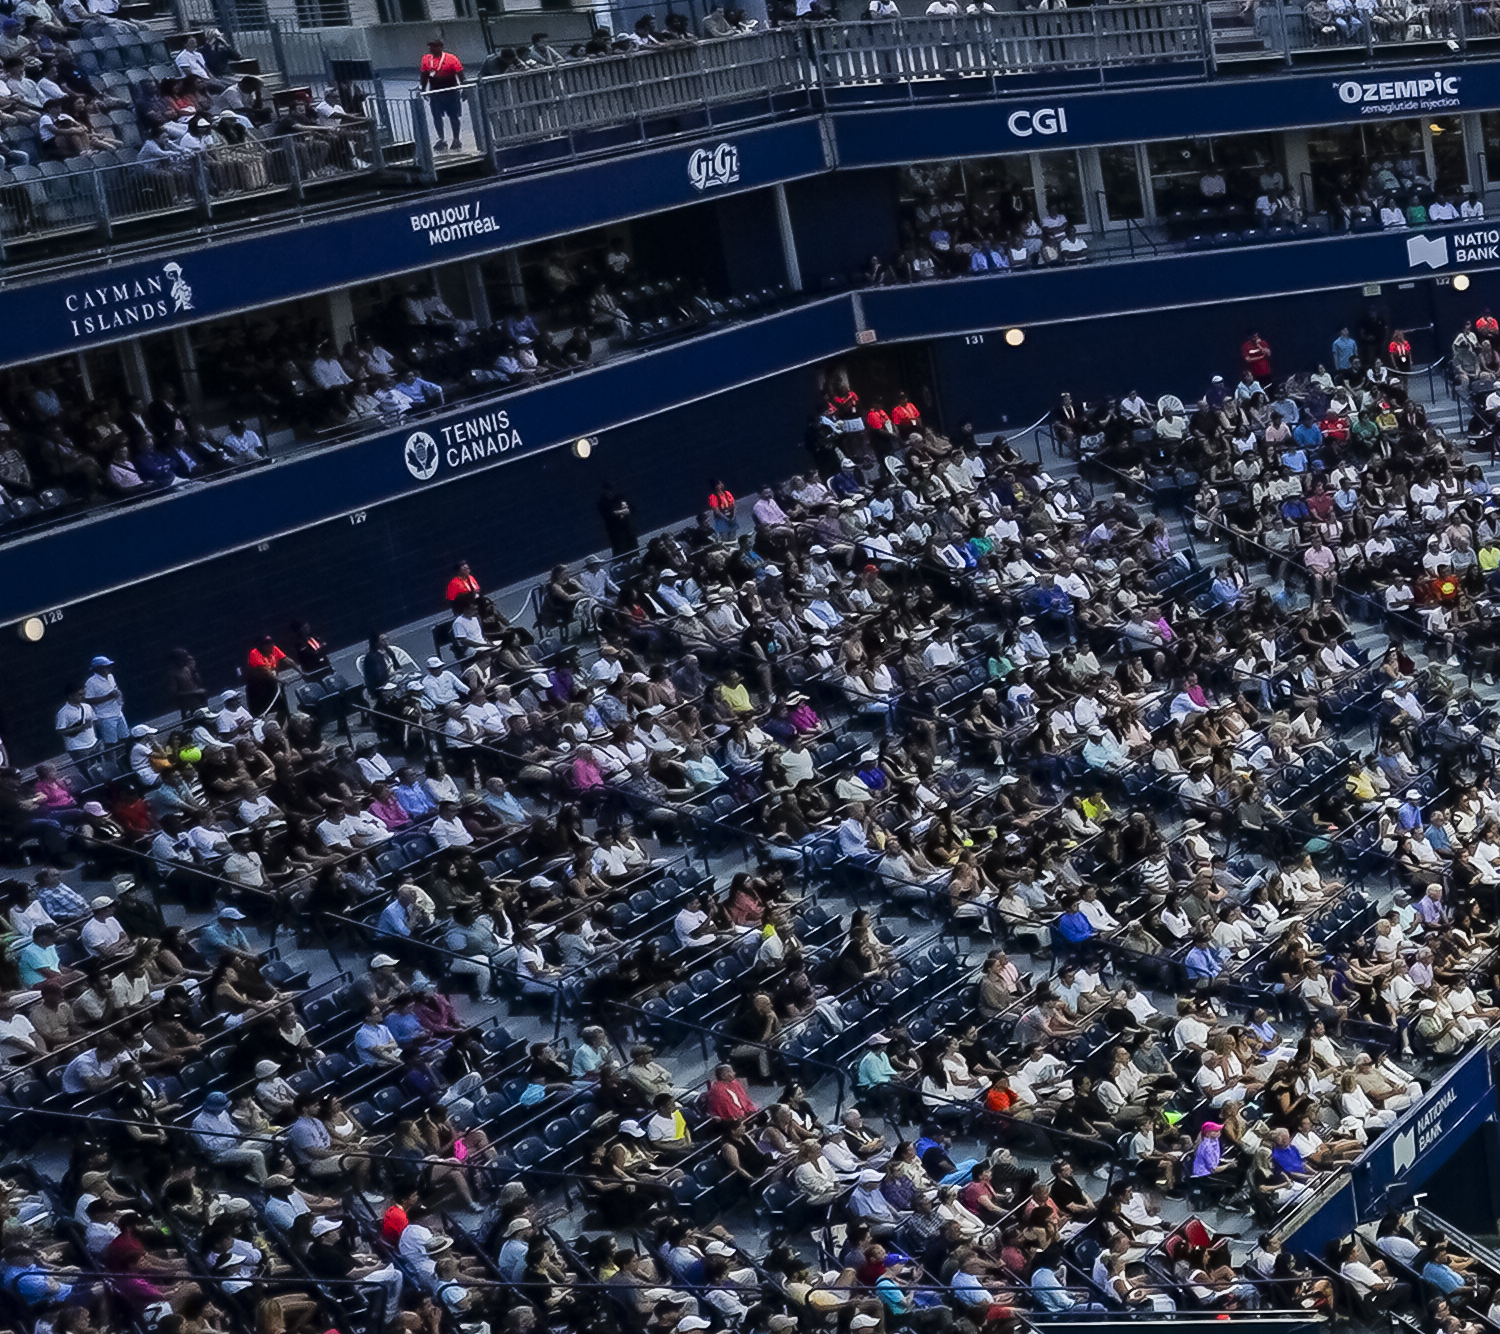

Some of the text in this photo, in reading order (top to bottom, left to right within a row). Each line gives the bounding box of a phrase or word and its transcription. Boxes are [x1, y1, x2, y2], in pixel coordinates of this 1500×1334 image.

[1007, 107, 1068, 138] CGI
[1456, 245, 1500, 263] BANK
[65, 274, 165, 312] CAYMAN
[71, 299, 168, 338] ISLANDS
[440, 409, 511, 447] TENNIS
[445, 428, 524, 469] CANADA
[1417, 1087, 1458, 1135] NATIONAL
[1418, 1119, 1443, 1153] BANK
